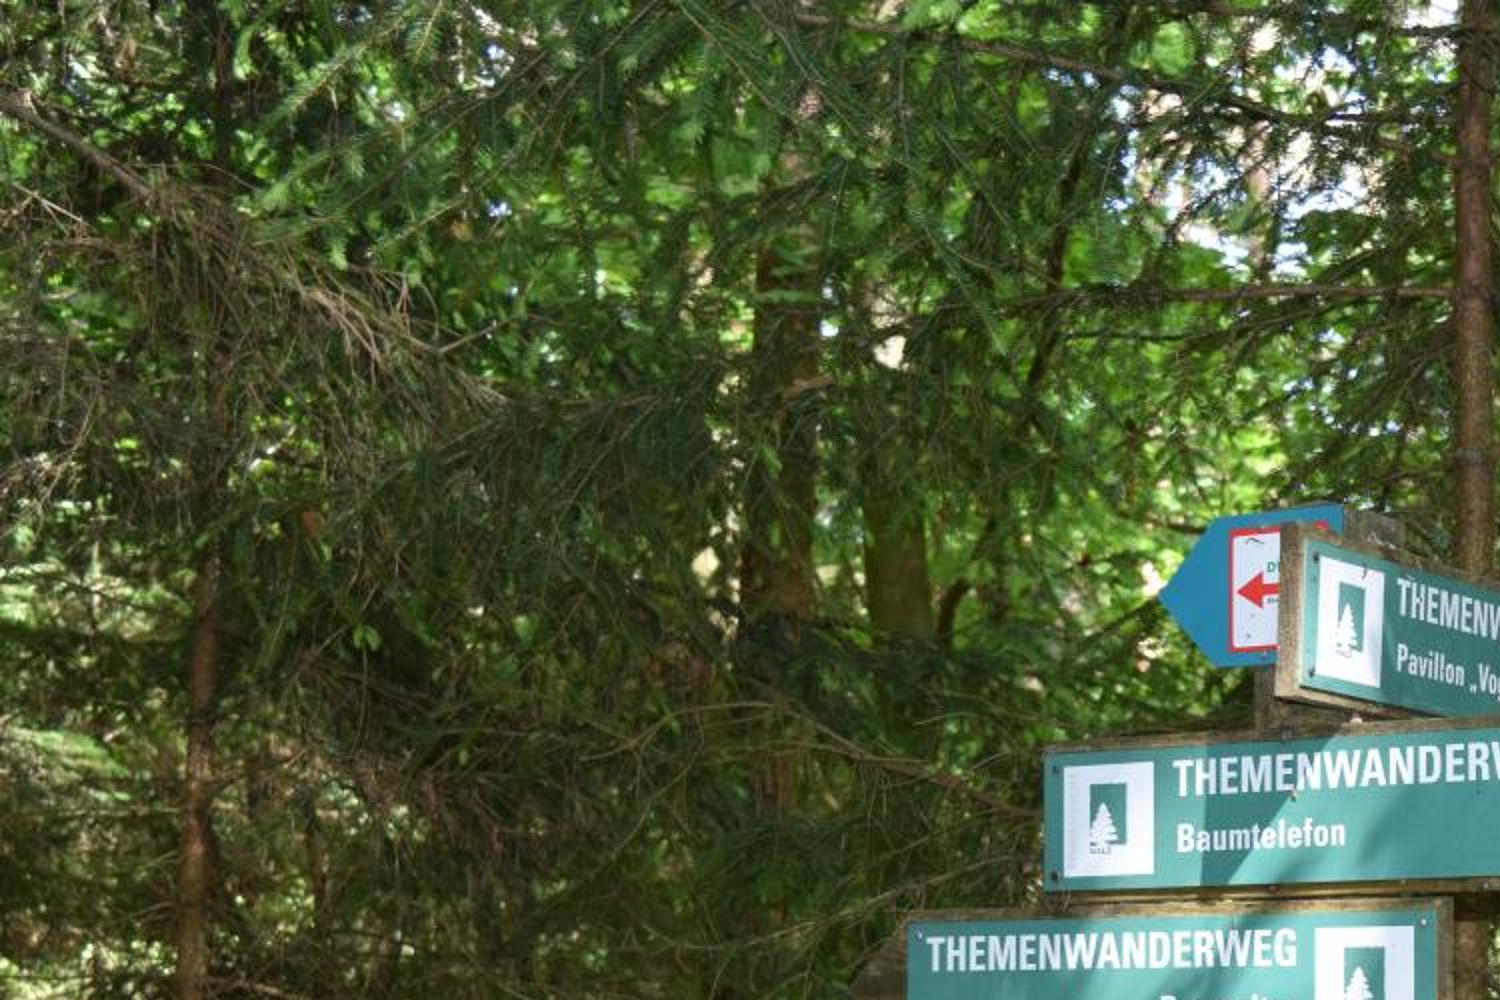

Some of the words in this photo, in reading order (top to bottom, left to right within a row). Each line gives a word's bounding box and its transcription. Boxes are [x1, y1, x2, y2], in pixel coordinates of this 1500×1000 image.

[1397, 643, 1465, 687] Pavillon
[1177, 818, 1346, 853] Baumtelefon
[926, 928, 1297, 972] THEMENWANDERWEG
